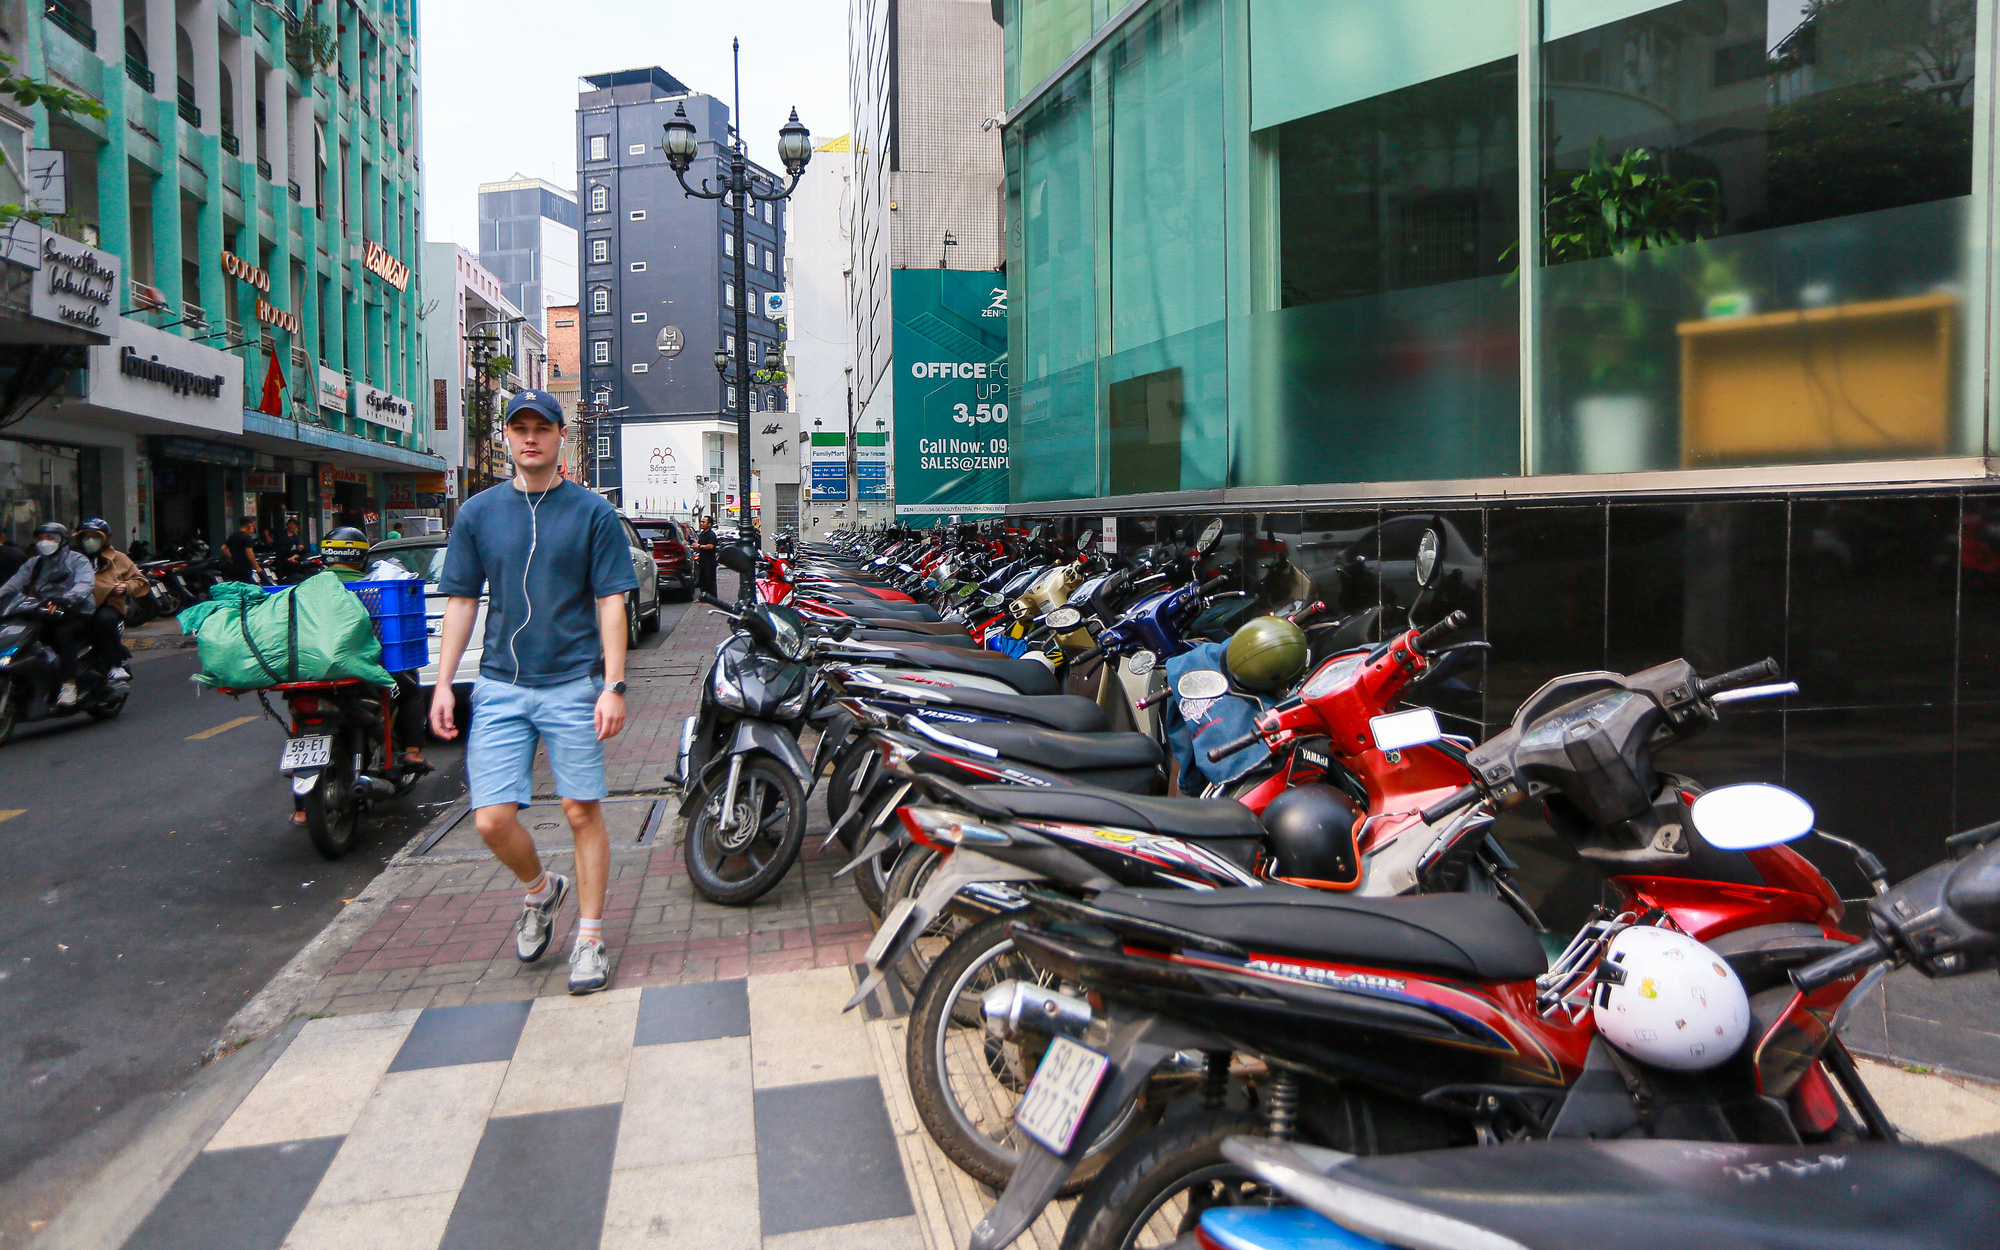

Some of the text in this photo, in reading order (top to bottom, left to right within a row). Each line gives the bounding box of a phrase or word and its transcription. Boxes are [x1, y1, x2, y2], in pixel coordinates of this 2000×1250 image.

[43, 237, 116, 292] Something
[222, 251, 270, 292] GOOOD
[48, 265, 112, 306] fabulous
[59, 304, 102, 328] inside
[256, 298, 299, 335] HOOOD
[911, 362, 986, 379] OFFICE
[976, 383, 1000, 400] UP
[952, 403, 1008, 427] 3,50
[920, 438, 1009, 454] Call Now: 09
[650, 464, 667, 473] Sống
[390, 484, 412, 501] 35
[813, 517, 820, 526] P
[916, 708, 977, 723] VISION
[292, 739, 324, 753] 59-E1
[1302, 748, 1329, 768] YAMAHA
[1046, 1043, 1095, 1096] 59-X2
[1020, 1082, 1078, 1144] 227.76
